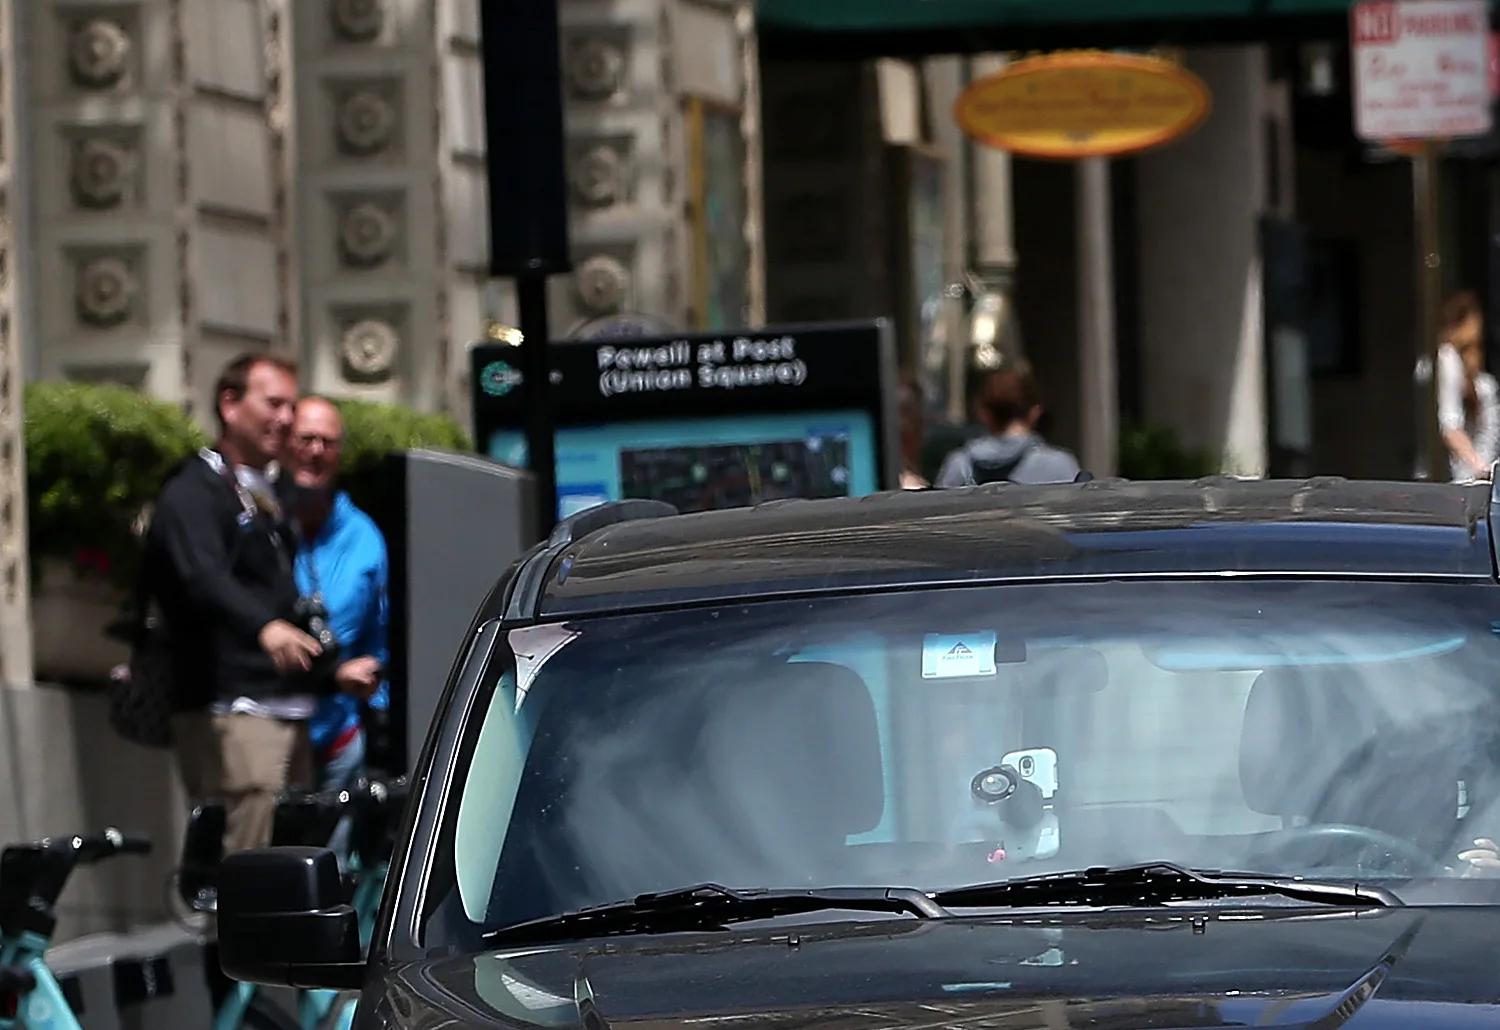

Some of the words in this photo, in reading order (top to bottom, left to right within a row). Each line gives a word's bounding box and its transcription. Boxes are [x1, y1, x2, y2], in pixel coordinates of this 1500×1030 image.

[598, 340, 691, 369] Powell
[697, 341, 725, 363] at
[733, 336, 796, 361] Post
[600, 368, 692, 397] (Union
[698, 358, 808, 389] Square)
